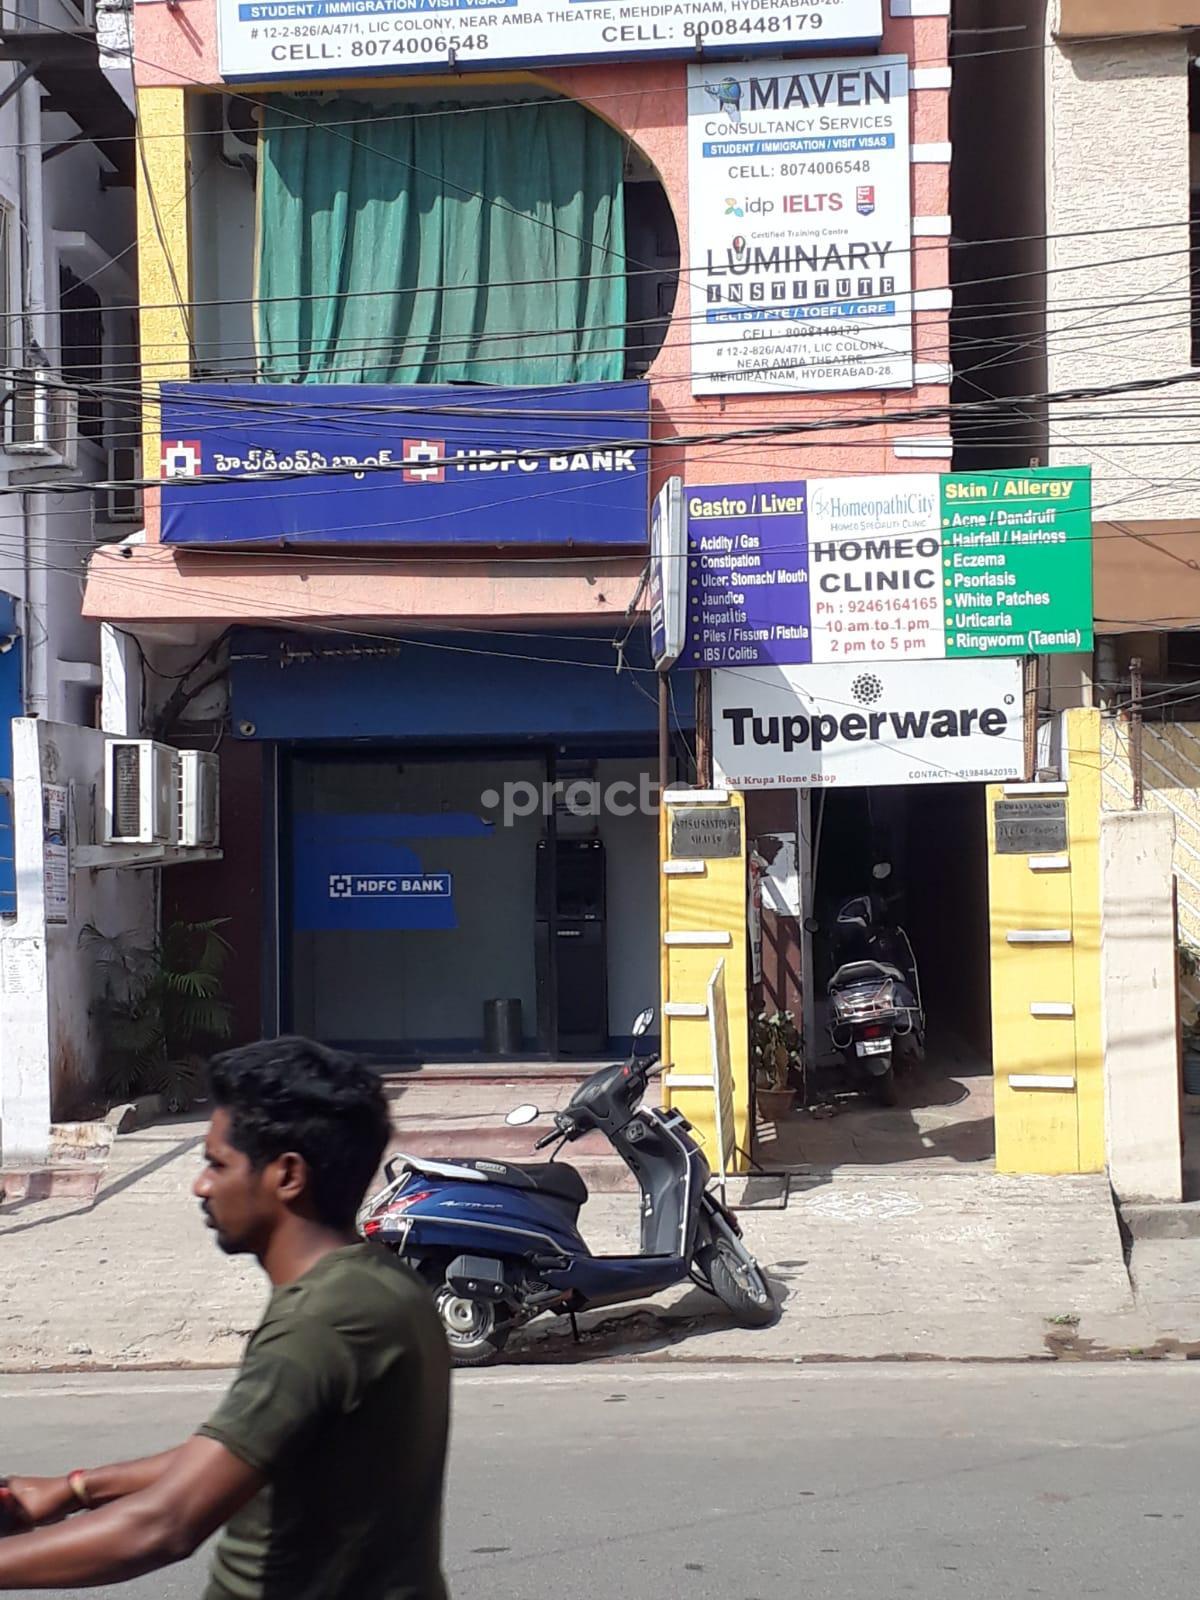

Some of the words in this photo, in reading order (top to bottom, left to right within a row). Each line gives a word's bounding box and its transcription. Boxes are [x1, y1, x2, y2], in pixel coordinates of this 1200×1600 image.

[251, 4, 314, 18] STUDENT
[325, 0, 416, 14] IMMIGRATION
[429, 0, 461, 8] VISIT
[251, 28, 258, 39] #
[369, 21, 389, 32] LIC
[394, 18, 455, 31] COLONY,
[460, 15, 498, 28] NEAR
[502, 13, 543, 25] AMBA
[547, 8, 615, 22] THEATRE,
[620, 2, 727, 18] MEHDIPATNAM,
[602, 24, 674, 42] CELL:
[683, 13, 823, 38] 8008448179
[271, 43, 342, 61] CELL:
[351, 34, 489, 57] 8074006548
[750, 70, 891, 110] MAVEN
[705, 119, 815, 136] CONSULTANCY
[819, 115, 892, 131] SERVICES
[711, 143, 754, 155] STUDENT
[761, 140, 825, 153] IMMIGRATION
[832, 138, 856, 149] VISIT
[858, 136, 887, 148] VISAS
[728, 164, 775, 179] CELL:
[780, 160, 870, 176] 8074006548
[745, 197, 774, 216] idp
[783, 193, 843, 213] IELTS
[707, 241, 893, 276] LUMINARY
[707, 276, 895, 303] INSTITUTE
[801, 306, 848, 317] TOEFL
[857, 303, 887, 314] GRE
[814, 344, 832, 353] LIC
[737, 358, 768, 369] NEAR
[457, 450, 539, 471] HDFC
[550, 449, 637, 471] BANK
[945, 482, 987, 499] Skin
[1004, 480, 1074, 497] Allergy
[689, 497, 747, 516] Gastro
[761, 494, 804, 513] Liver
[952, 512, 986, 527] Acne
[997, 508, 1056, 526] Dandruff
[700, 536, 733, 552] Acidity
[740, 534, 760, 548] Gas
[953, 530, 1000, 547] Hairfall
[1011, 529, 1066, 545] Hairloss
[814, 537, 940, 562] HOMEO
[700, 553, 760, 570] Constipation
[953, 552, 1005, 568] Eczema
[777, 568, 808, 583] Mouth
[819, 569, 935, 592] CLINIC
[954, 571, 1016, 588] Psoriasis
[702, 591, 745, 606] Jaundice
[816, 602, 834, 614] Ph
[848, 597, 938, 613] 9246164165
[954, 592, 993, 608] White
[996, 591, 1050, 606] Patches
[702, 607, 747, 626] Hepatitis
[826, 620, 843, 632] 10
[848, 622, 869, 632] am
[874, 619, 889, 631] to
[894, 618, 901, 630] 1
[907, 619, 930, 632] pm
[955, 612, 1012, 628] Urticaria
[703, 629, 727, 642] Piles
[734, 627, 769, 641] Fissure
[776, 625, 809, 639] Fistula
[956, 632, 1025, 651] Ringworm
[1028, 629, 1081, 652] (Taenia)
[704, 647, 720, 661] IBS
[728, 646, 758, 660] Colitis
[830, 639, 839, 652] 2
[844, 641, 866, 654] pm
[871, 638, 885, 650] to
[890, 637, 898, 649] 5
[904, 638, 926, 652] pm
[723, 707, 1008, 751] Tupperware
[744, 776, 775, 786] Krupa
[778, 774, 808, 783] Home
[811, 773, 837, 784] Shop
[357, 880, 397, 892] HDFC
[402, 880, 443, 891] BANK
